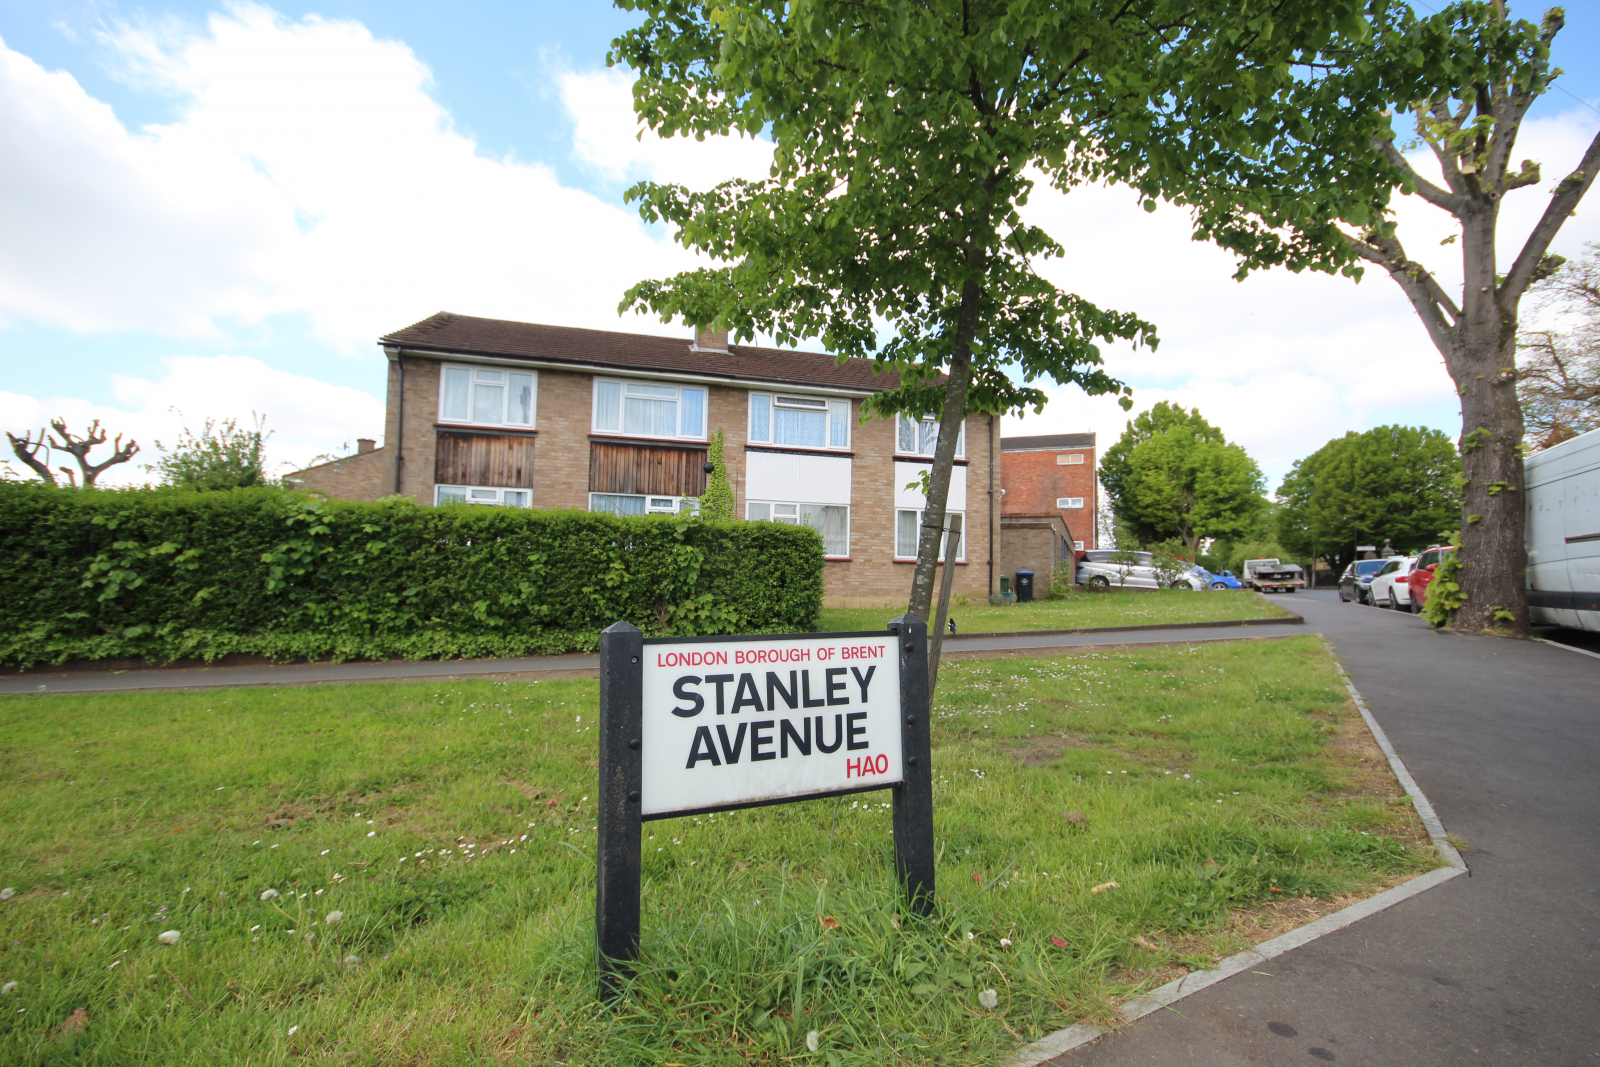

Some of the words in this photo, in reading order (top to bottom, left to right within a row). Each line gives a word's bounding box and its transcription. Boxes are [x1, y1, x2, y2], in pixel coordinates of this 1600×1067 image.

[657, 651, 728, 667] LONDON
[735, 648, 811, 664] BOROUGH
[816, 647, 836, 660] OF
[841, 645, 886, 660] BRENT
[671, 665, 877, 718] STANLEY
[685, 711, 869, 769] AVENUE
